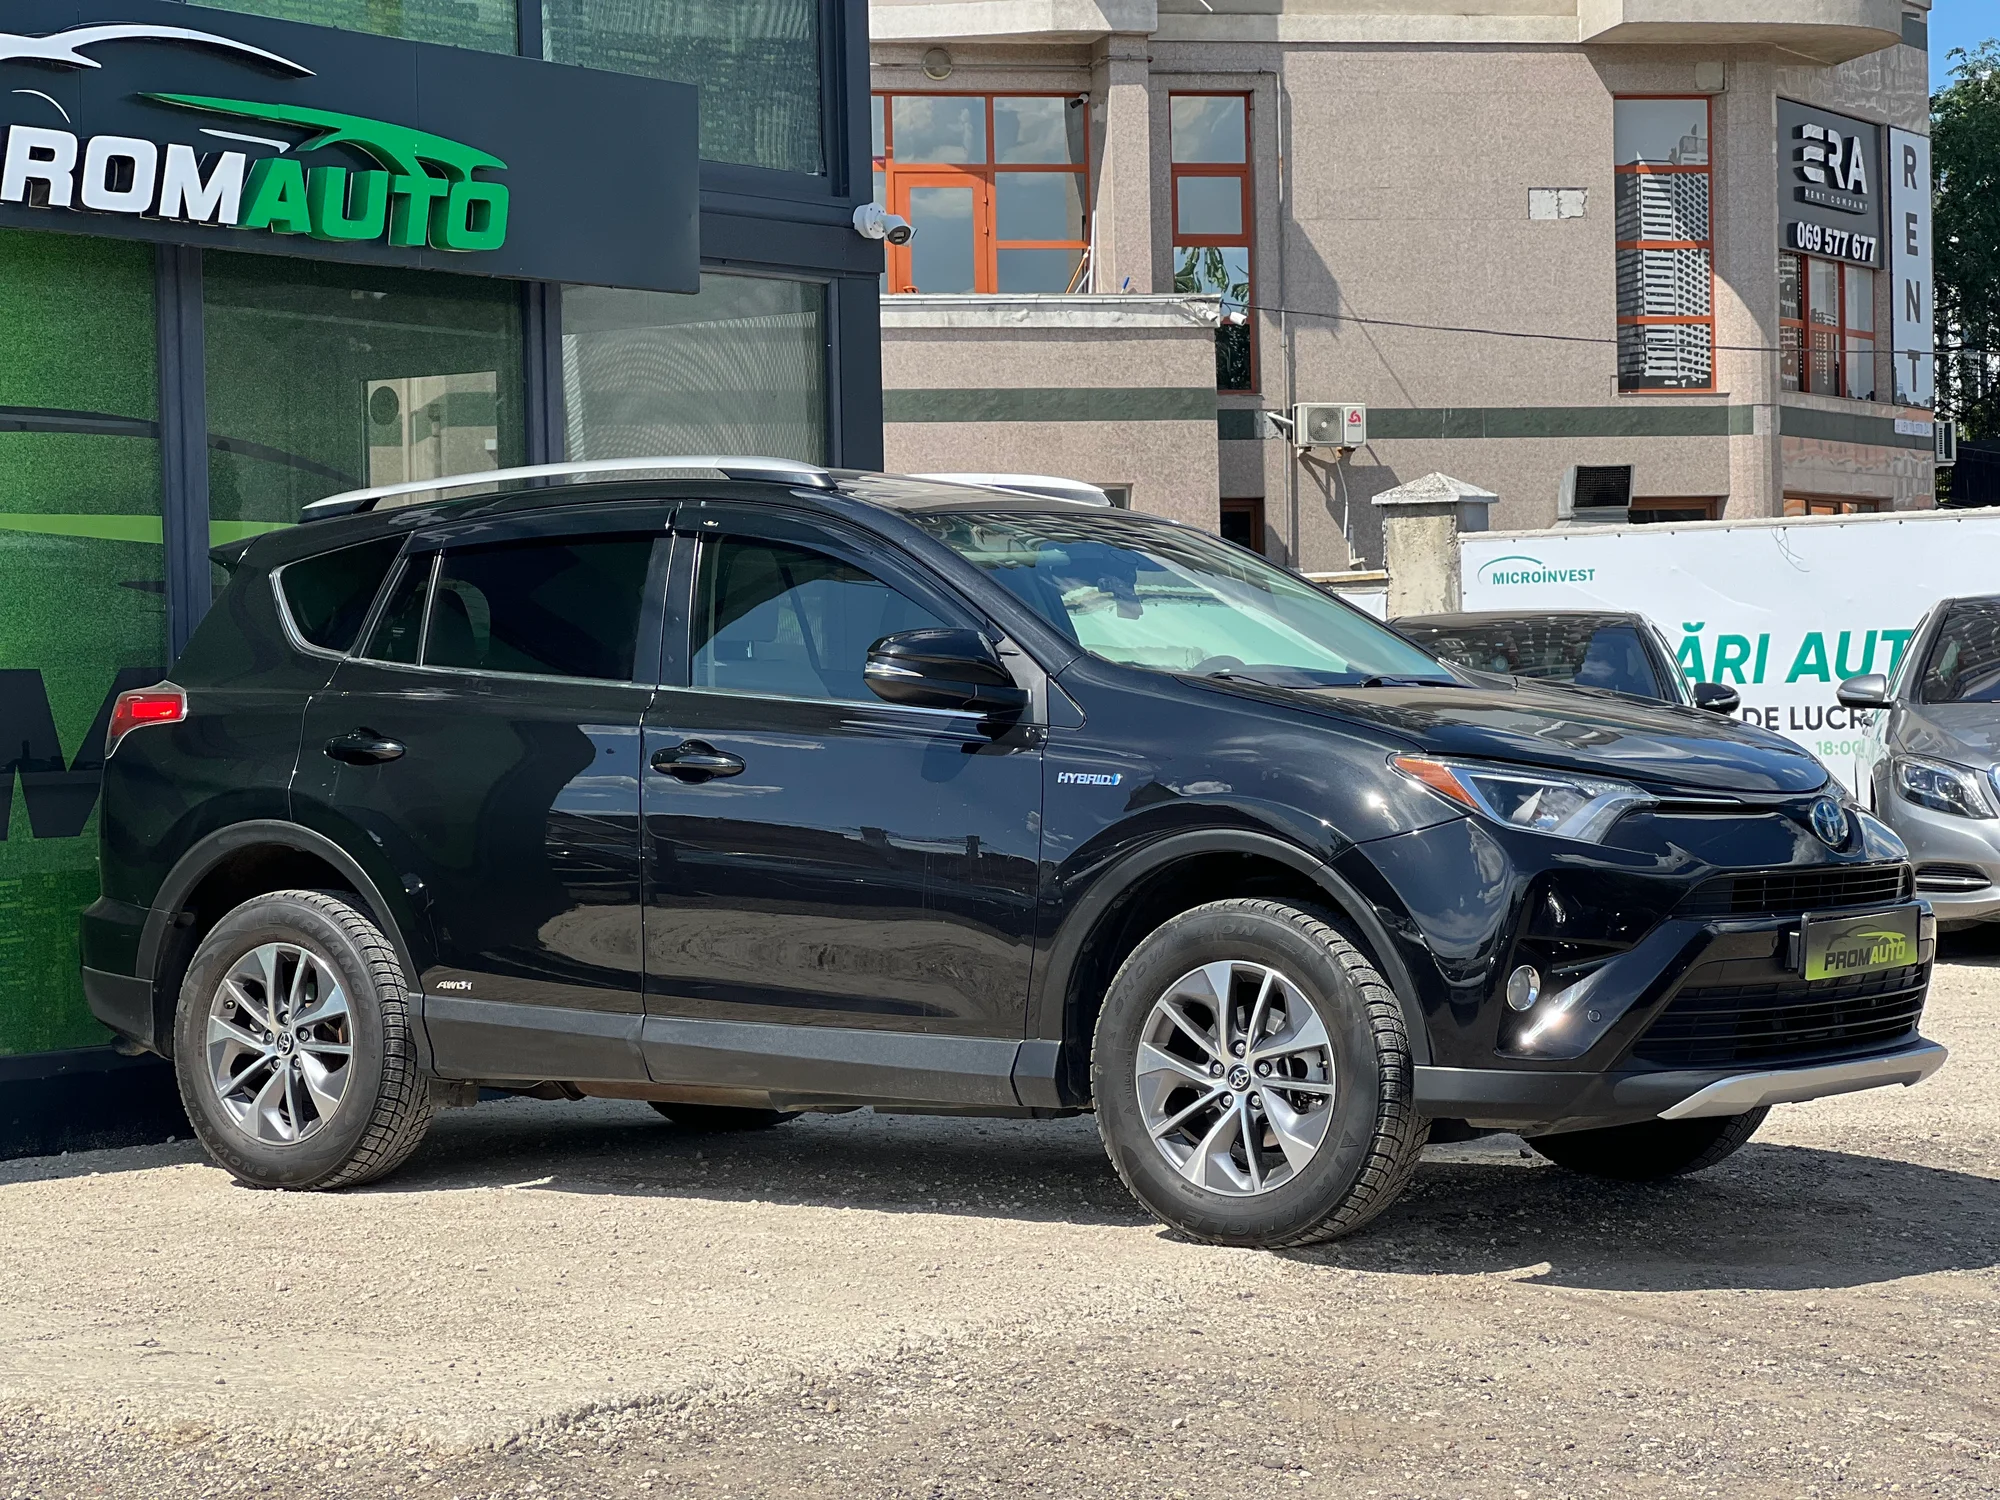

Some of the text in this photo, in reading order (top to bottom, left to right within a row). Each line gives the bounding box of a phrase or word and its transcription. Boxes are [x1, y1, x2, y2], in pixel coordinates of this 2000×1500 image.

[1803, 123, 1868, 194] ERA
[1804, 189, 1868, 211] RENT COMPANY
[1797, 221, 1876, 262] 069 577 677
[1903, 144, 1921, 392] RENT
[1742, 706, 1780, 731] DE
[1057, 772, 1111, 785] HYBRID
[1824, 941, 1906, 971] PROMAUTO
